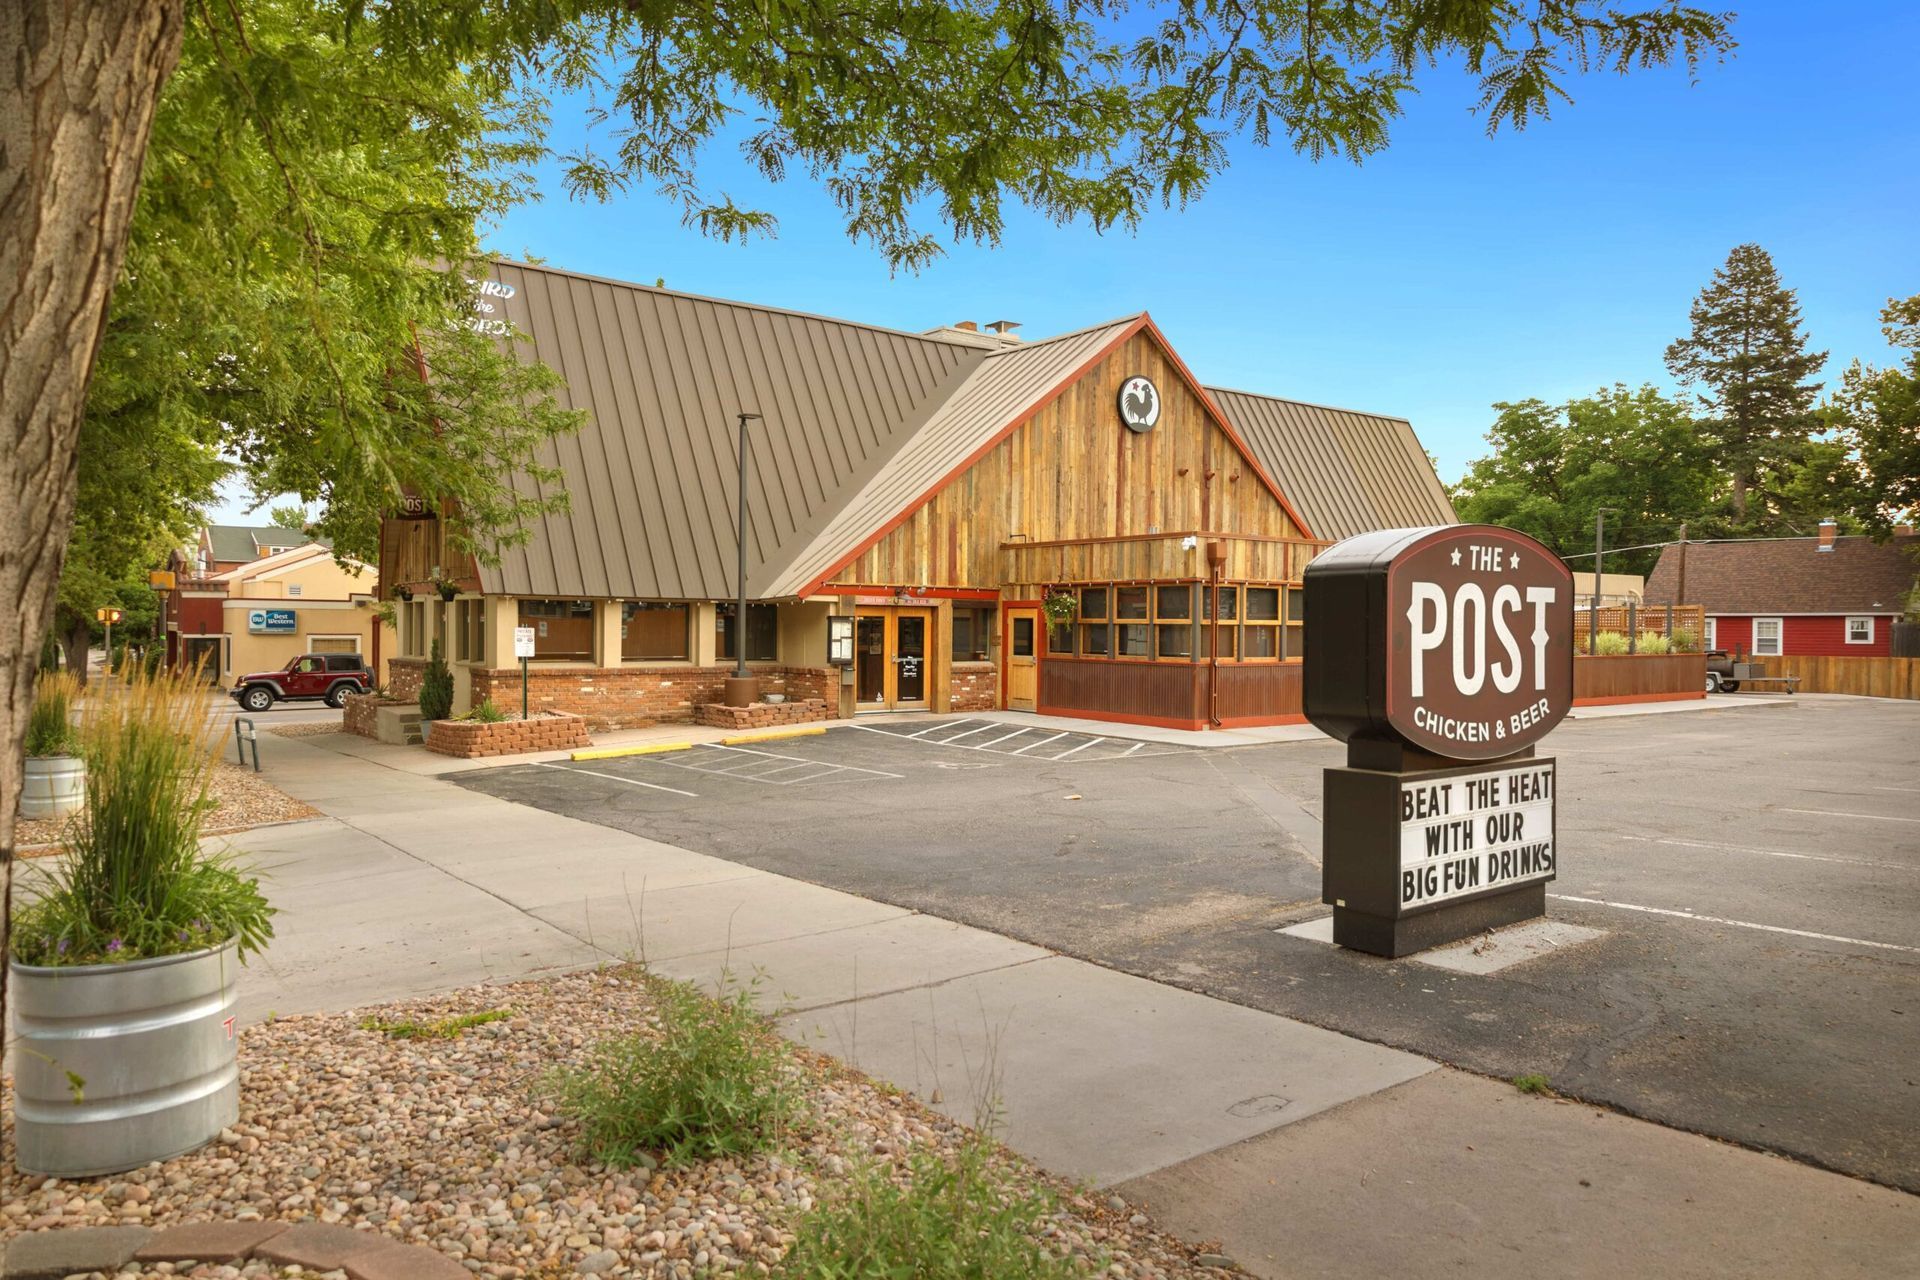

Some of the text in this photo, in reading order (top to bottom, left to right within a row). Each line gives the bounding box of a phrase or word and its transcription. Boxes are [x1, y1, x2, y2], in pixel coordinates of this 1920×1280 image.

[465, 279, 515, 299] IRD
[1470, 545, 1503, 572] THE
[1406, 581, 1556, 697] POST
[1413, 698, 1550, 742] CHICKEN & BEER
[1401, 771, 1552, 822] BEAT THE HEAT
[1425, 812, 1524, 857] WITH OUR
[1402, 843, 1552, 903] BIG FUN DRINKS
